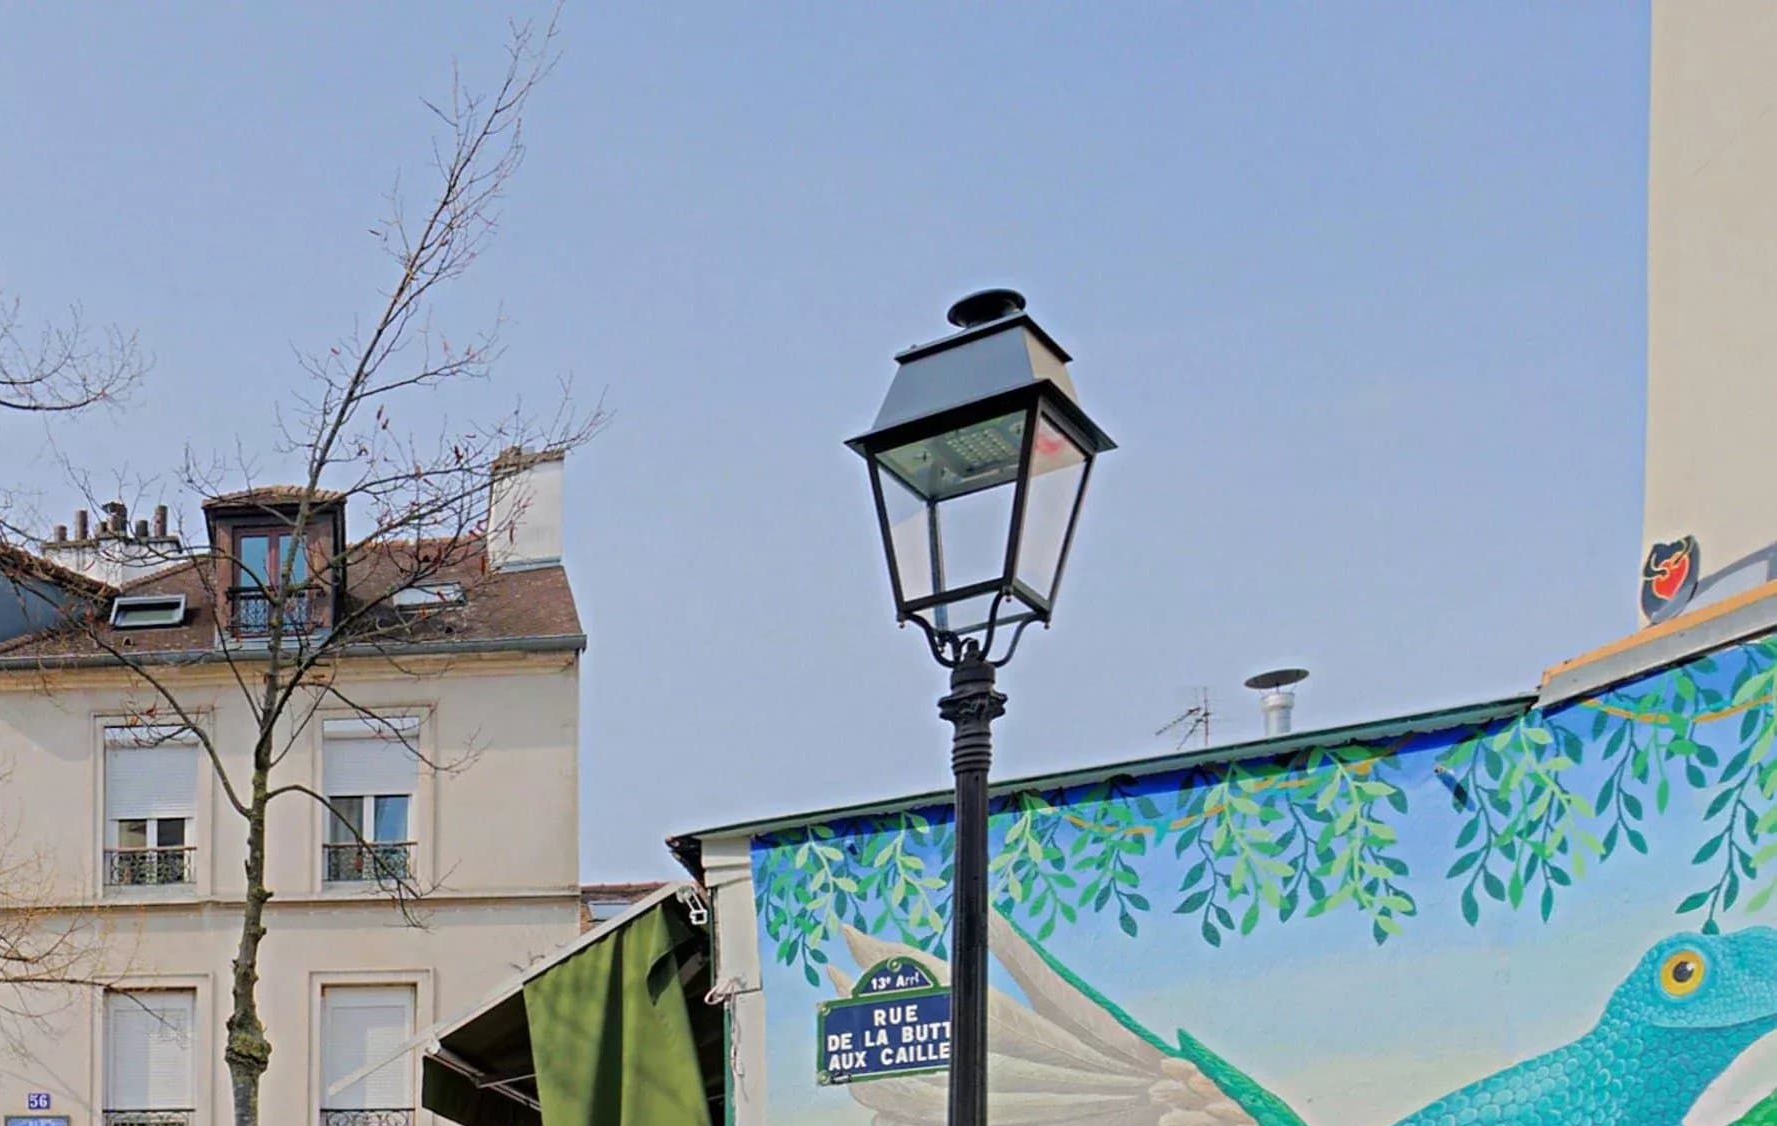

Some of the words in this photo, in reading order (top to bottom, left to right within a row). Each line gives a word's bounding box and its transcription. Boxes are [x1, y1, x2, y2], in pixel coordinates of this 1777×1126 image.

[873, 1004, 918, 1027] RUE
[827, 1033, 853, 1052] DE
[864, 1028, 889, 1048] LA
[901, 1021, 951, 1043] BUTT
[828, 1050, 867, 1071] AUX
[880, 1041, 951, 1066] CAILLE
[29, 1094, 48, 1108] 56
